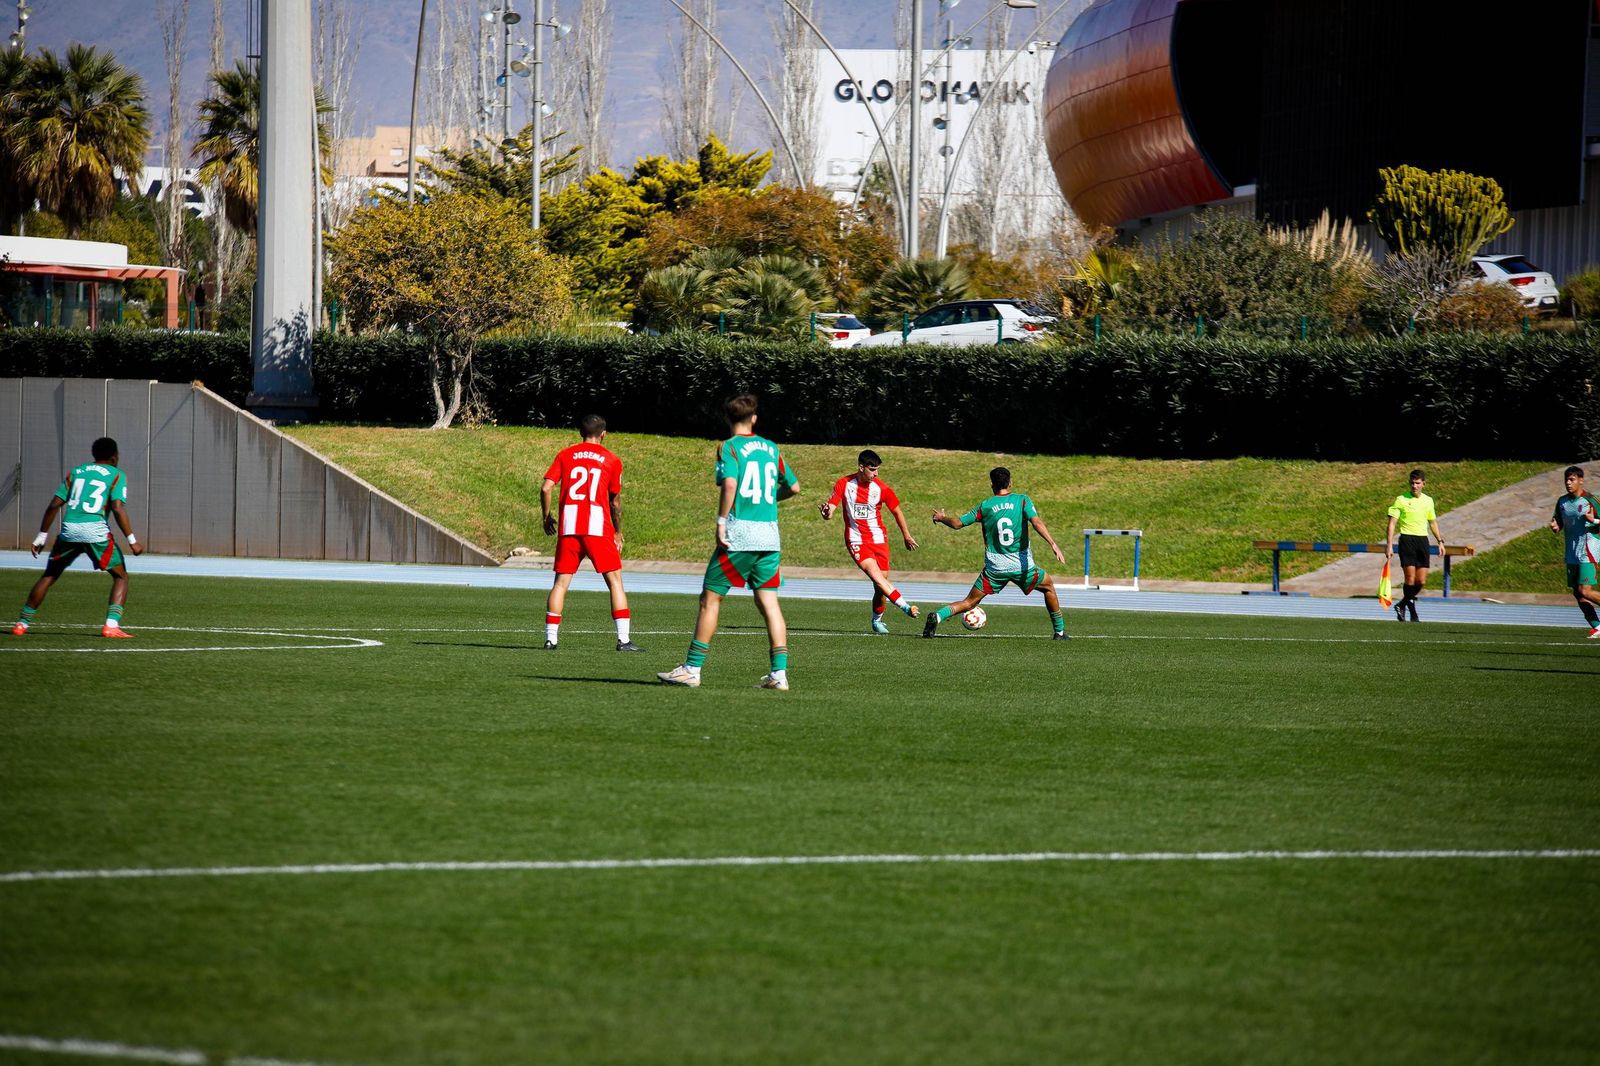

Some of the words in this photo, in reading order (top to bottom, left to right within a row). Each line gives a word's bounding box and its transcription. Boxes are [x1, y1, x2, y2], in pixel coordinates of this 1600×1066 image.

[573, 451, 606, 463] JOSEMA
[67, 478, 107, 514] 43
[569, 466, 602, 502] 21
[739, 461, 778, 505] 46
[996, 517, 1014, 546] 6
